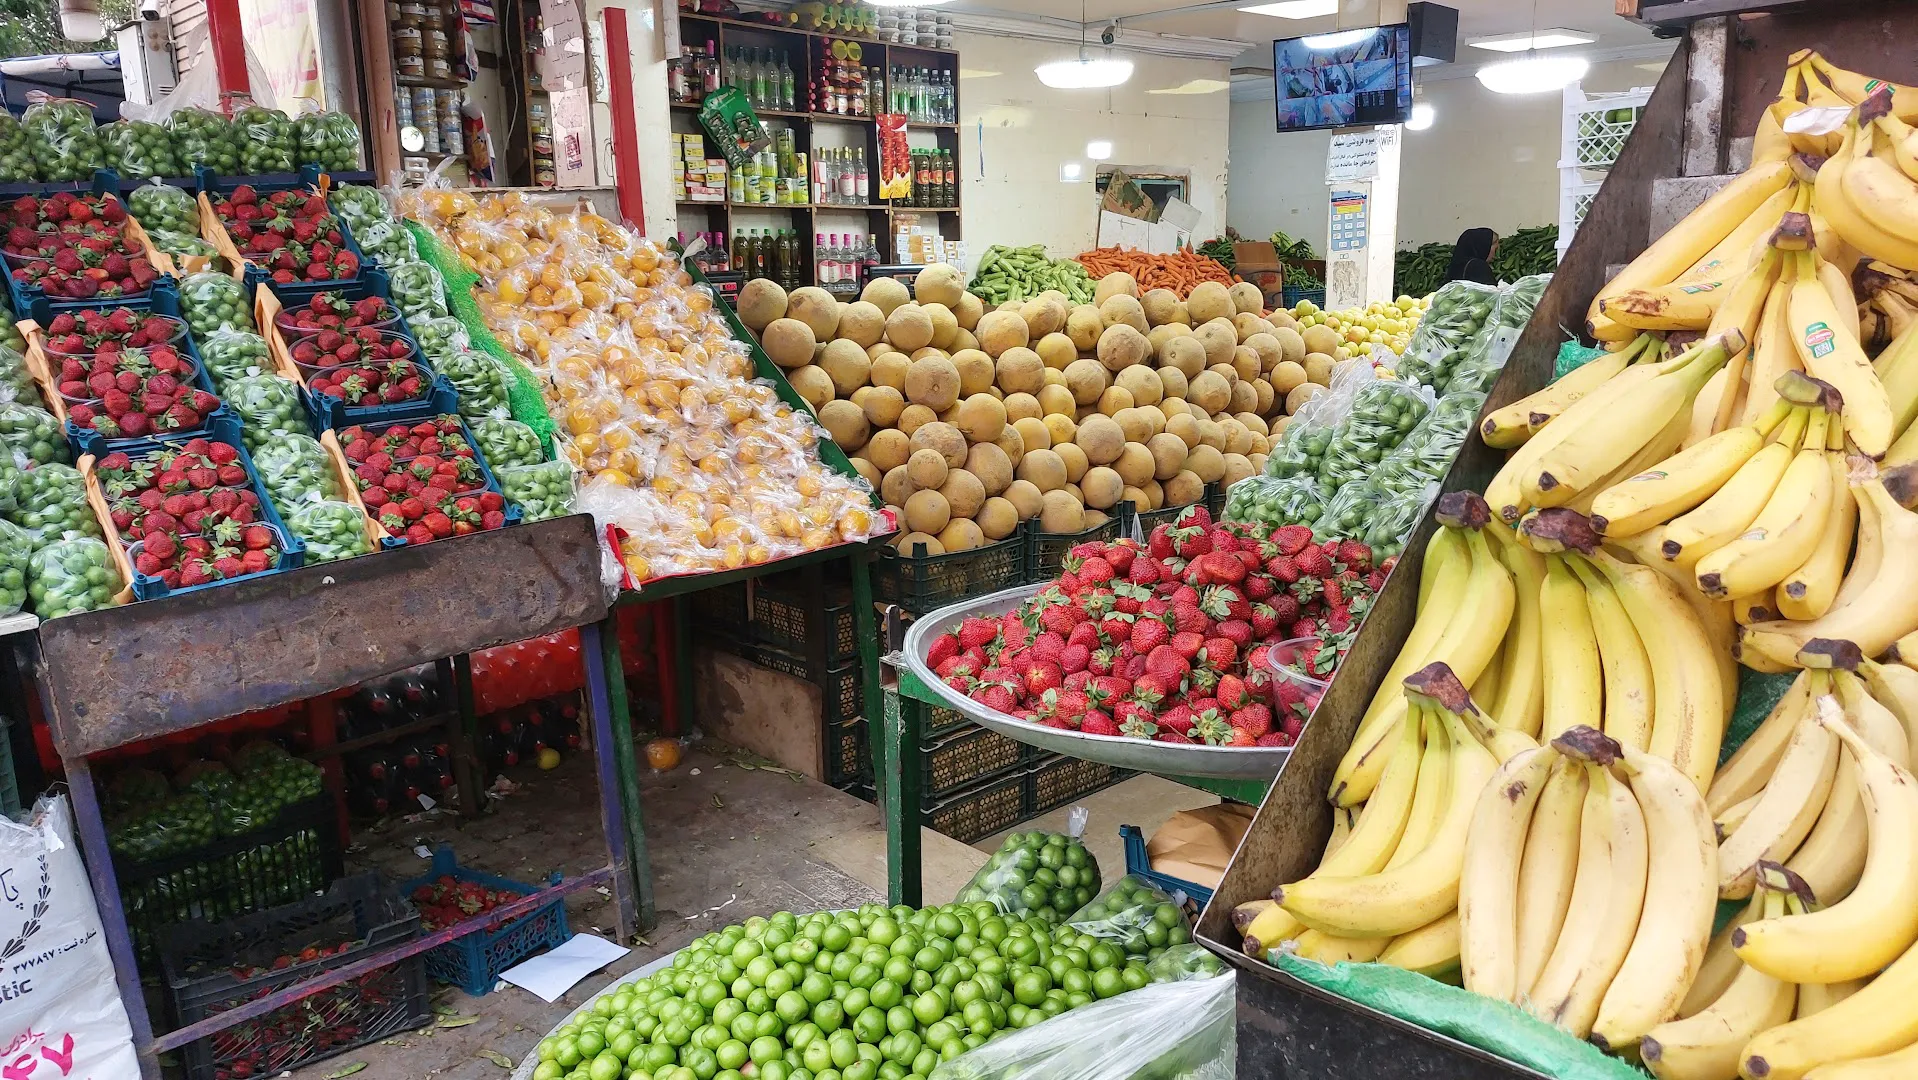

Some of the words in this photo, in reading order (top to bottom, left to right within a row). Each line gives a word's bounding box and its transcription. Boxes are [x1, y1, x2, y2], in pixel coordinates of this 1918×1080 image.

[1346, 137, 1364, 148] فروشی
[1365, 138, 1375, 146] میوه
[79, 928, 97, 944] شماره
[63, 938, 79, 952] ثبت
[0, 979, 33, 1004] tic
